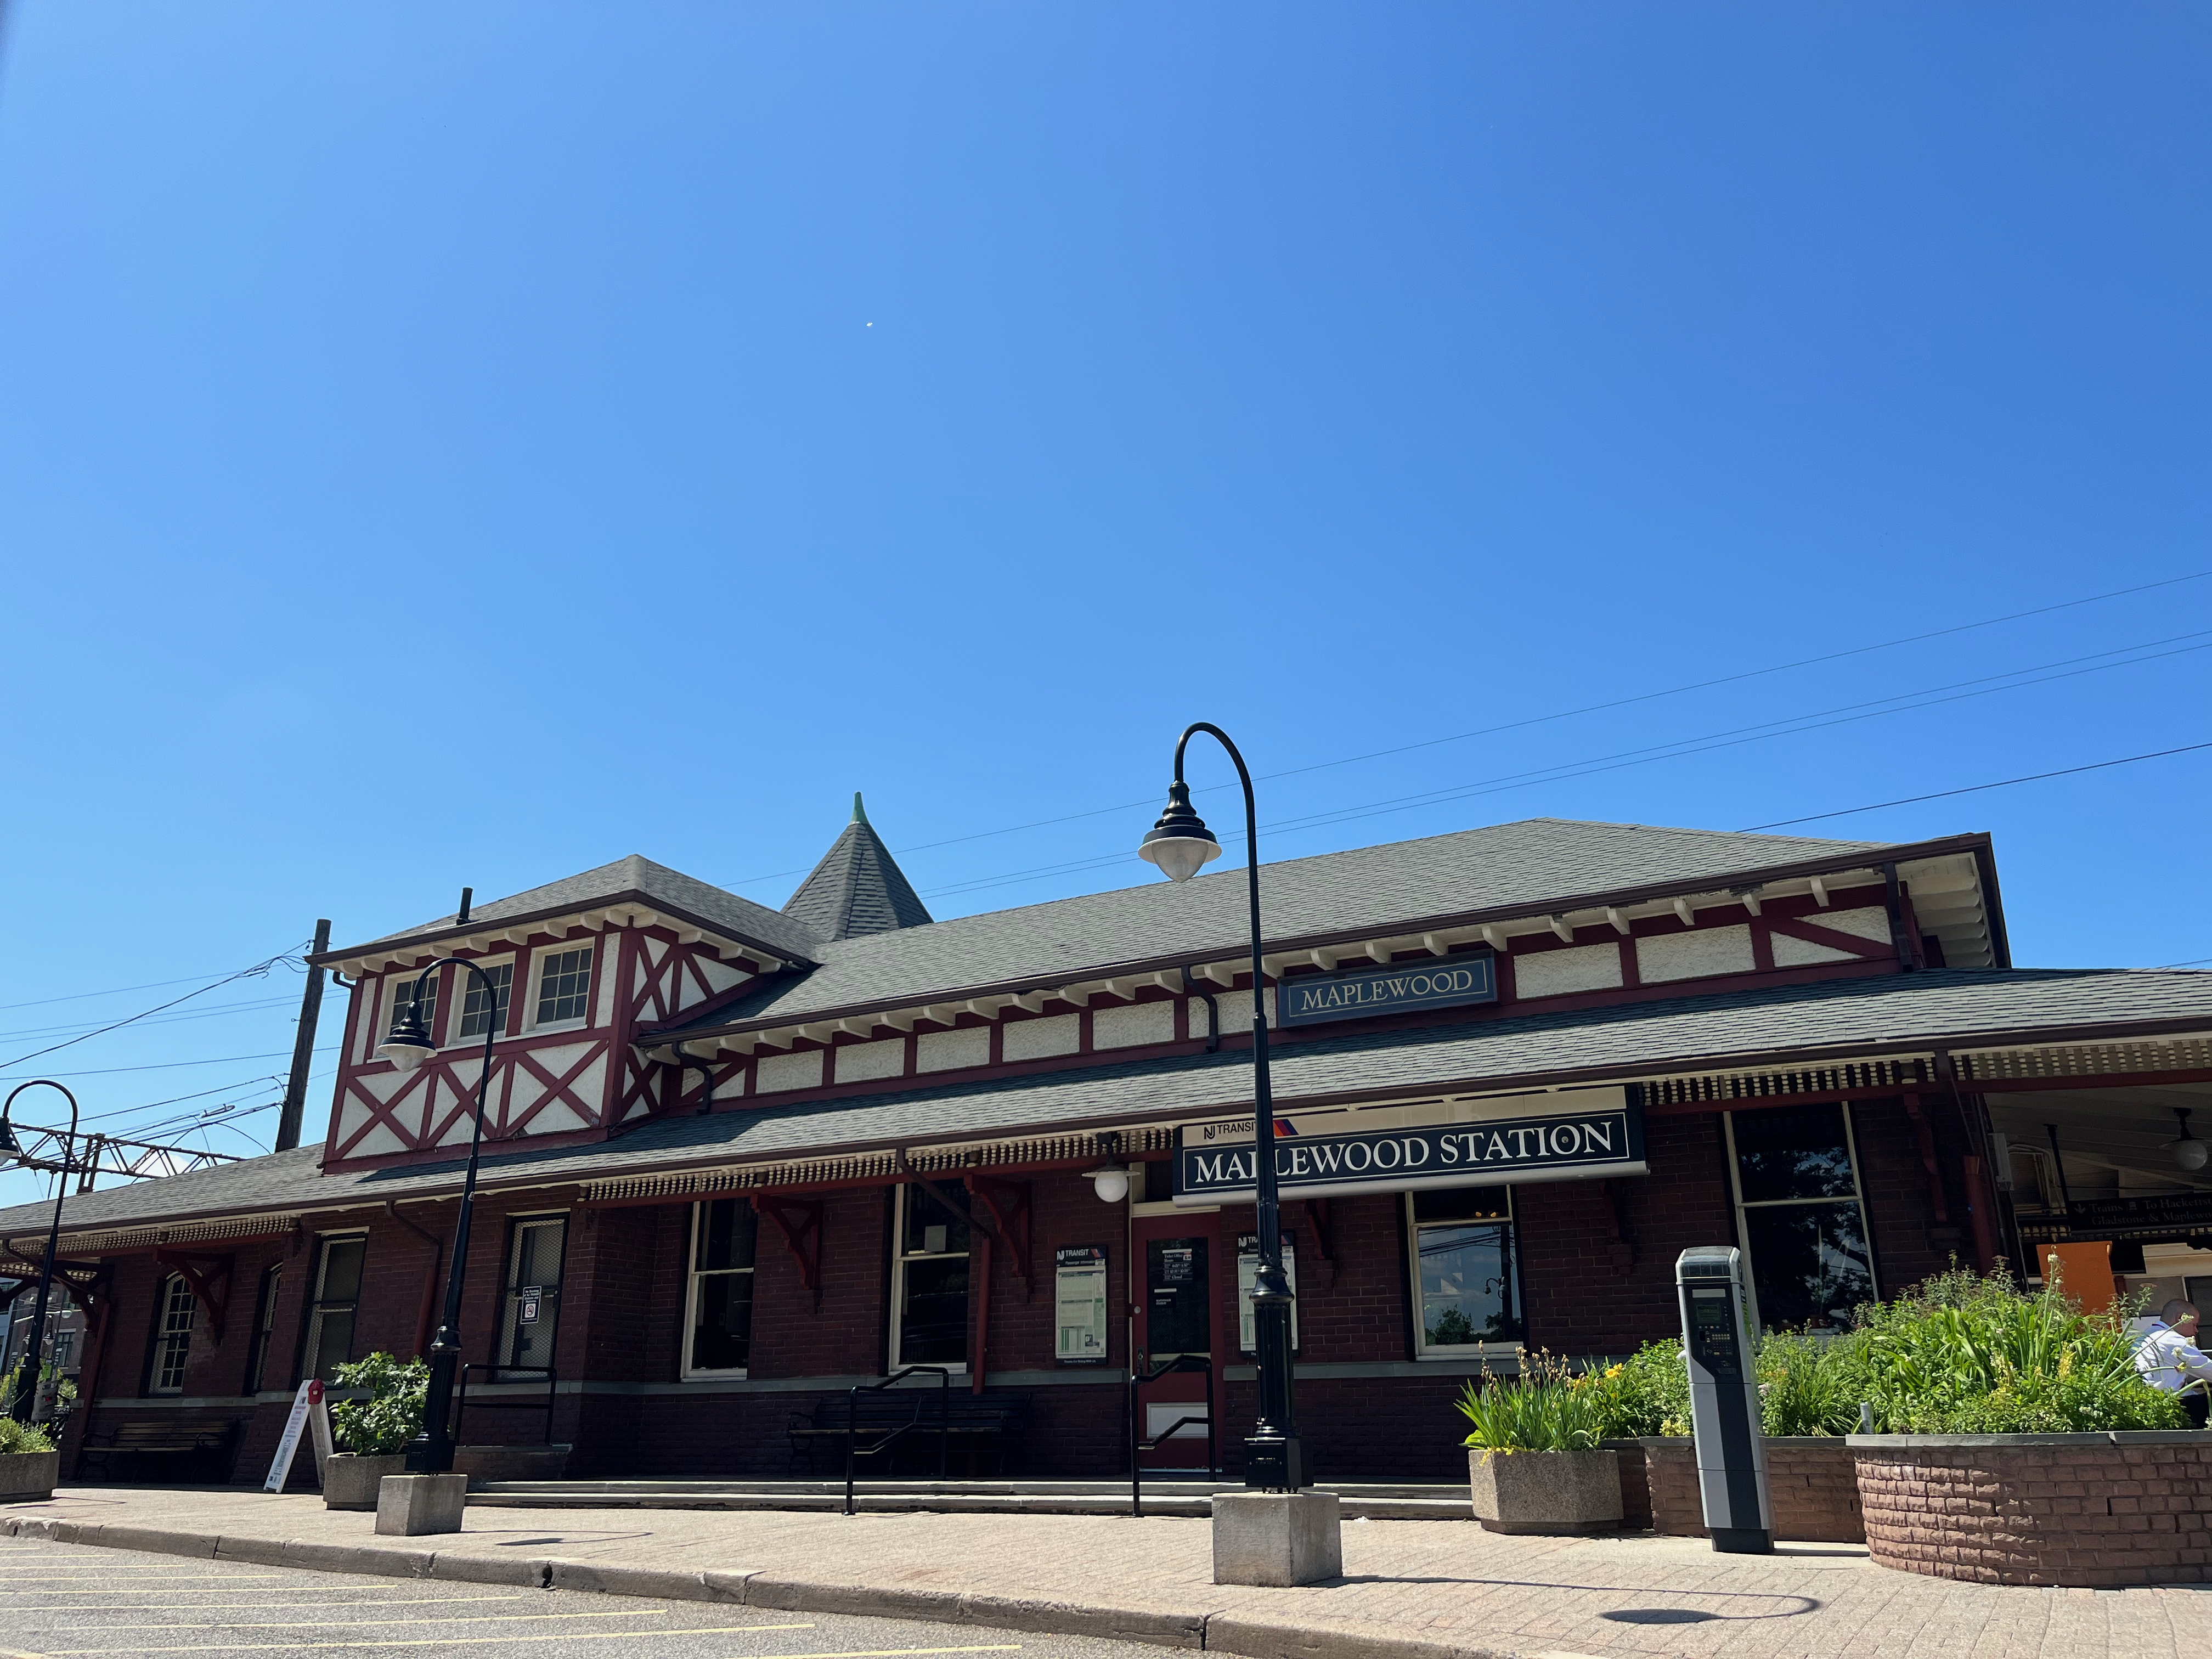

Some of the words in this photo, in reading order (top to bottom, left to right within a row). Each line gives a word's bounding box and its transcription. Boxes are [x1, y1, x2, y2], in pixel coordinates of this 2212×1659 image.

[1301, 970, 1472, 1010] MAPLEWOOD
[1204, 1125, 1215, 1139] NJ
[1217, 1121, 1256, 1134] TRANSI
[1440, 1122, 1612, 1164] STATION
[2089, 1203, 2123, 1213] Trains
[2142, 1200, 2157, 1210] To
[2092, 1215, 2145, 1225] Gladstone
[2148, 1212, 2160, 1222] &
[2163, 1210, 2212, 1222] Maplewo
[1238, 1237, 1247, 1247] NJ
[1057, 1250, 1065, 1260] NJ
[1065, 1249, 1089, 1257] TRANSIT
